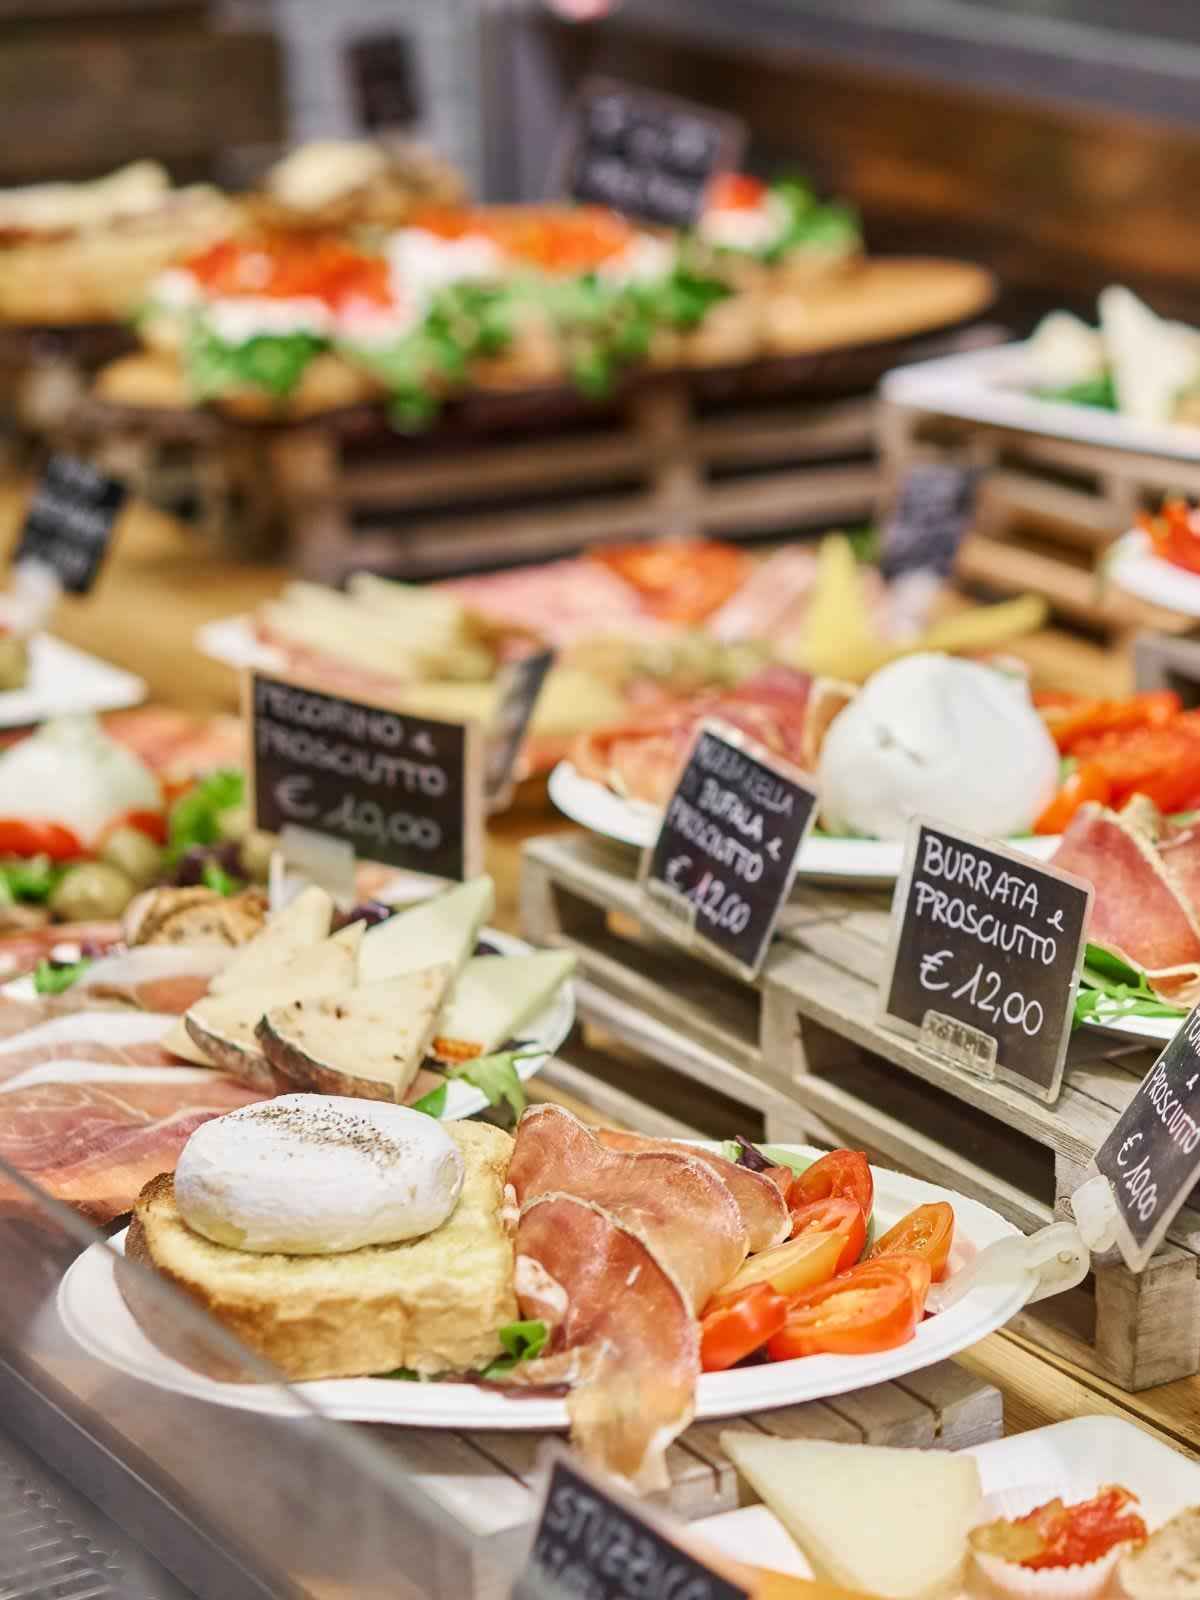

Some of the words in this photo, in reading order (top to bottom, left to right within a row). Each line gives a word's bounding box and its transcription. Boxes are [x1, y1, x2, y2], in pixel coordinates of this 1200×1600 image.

[257, 680, 403, 747] PECORINO
[258, 719, 448, 797] PROSCIUTTO
[273, 774, 319, 817] €
[322, 794, 442, 849] 10,00
[668, 793, 764, 882] PROSCIUTTO
[923, 835, 1039, 917] BURRATA
[915, 881, 1056, 965] PROSCIUTTO
[919, 951, 954, 990] €
[952, 963, 1043, 1035] 12,00
[1117, 1132, 1143, 1166] €
